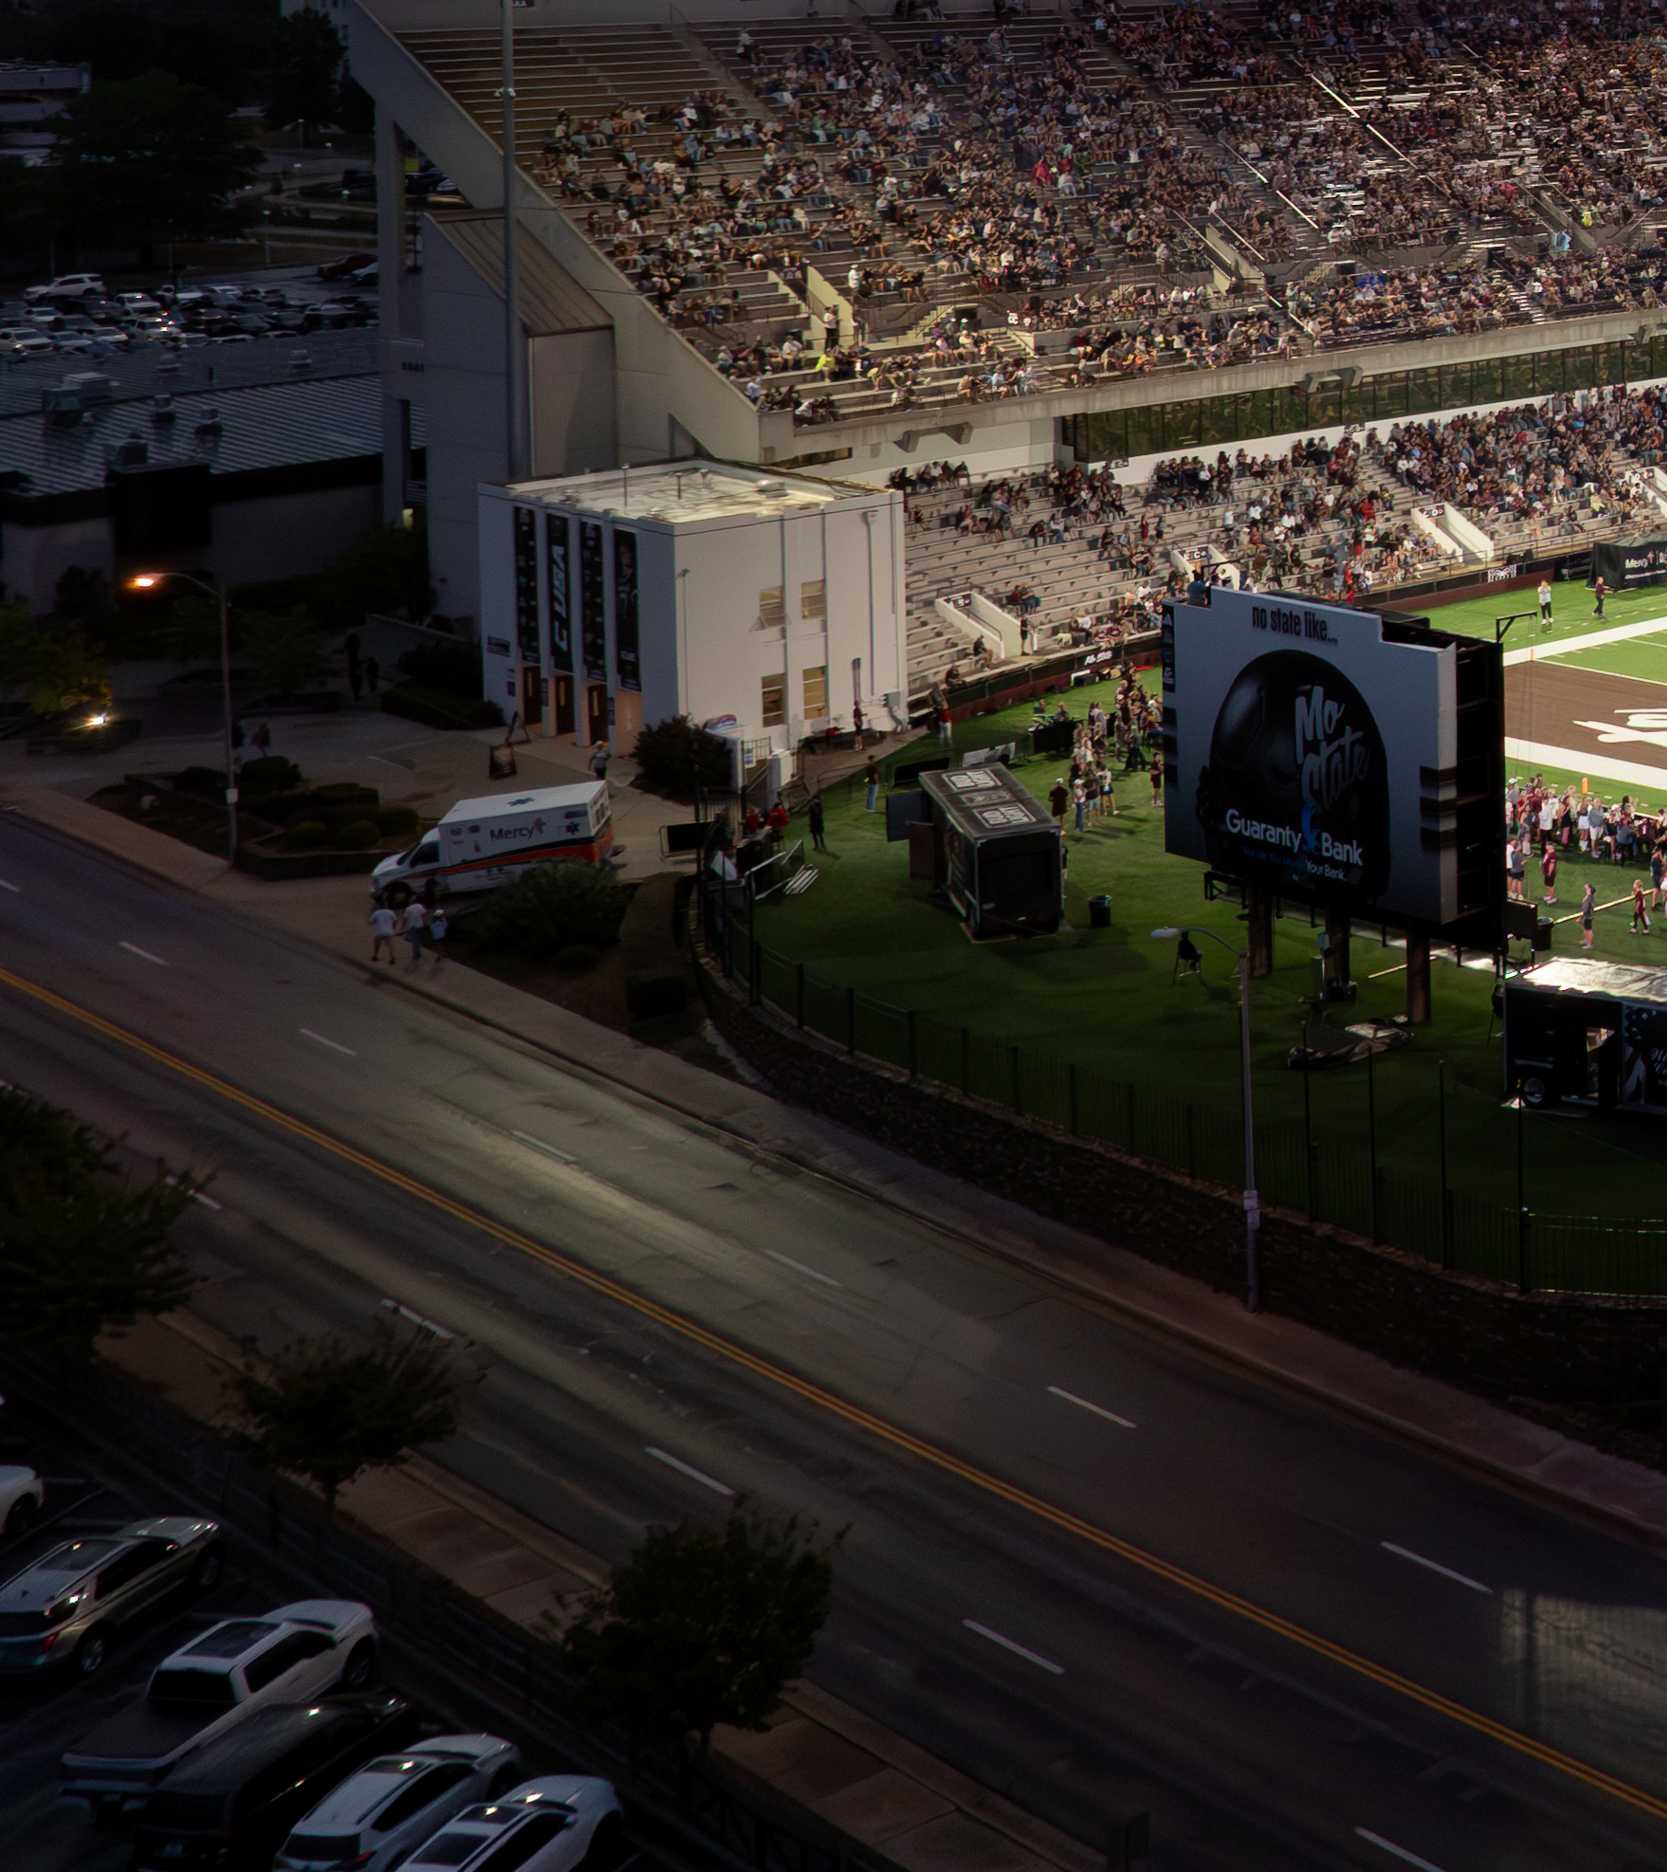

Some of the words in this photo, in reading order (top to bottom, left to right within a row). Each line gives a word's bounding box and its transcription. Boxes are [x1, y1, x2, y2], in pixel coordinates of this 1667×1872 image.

[1252, 607, 1267, 630] no
[1270, 609, 1301, 636] state
[1295, 686, 1345, 764] Mo
[490, 827, 534, 841] Mercy
[1225, 807, 1303, 853] Guaranty
[1321, 830, 1362, 866] Bank
